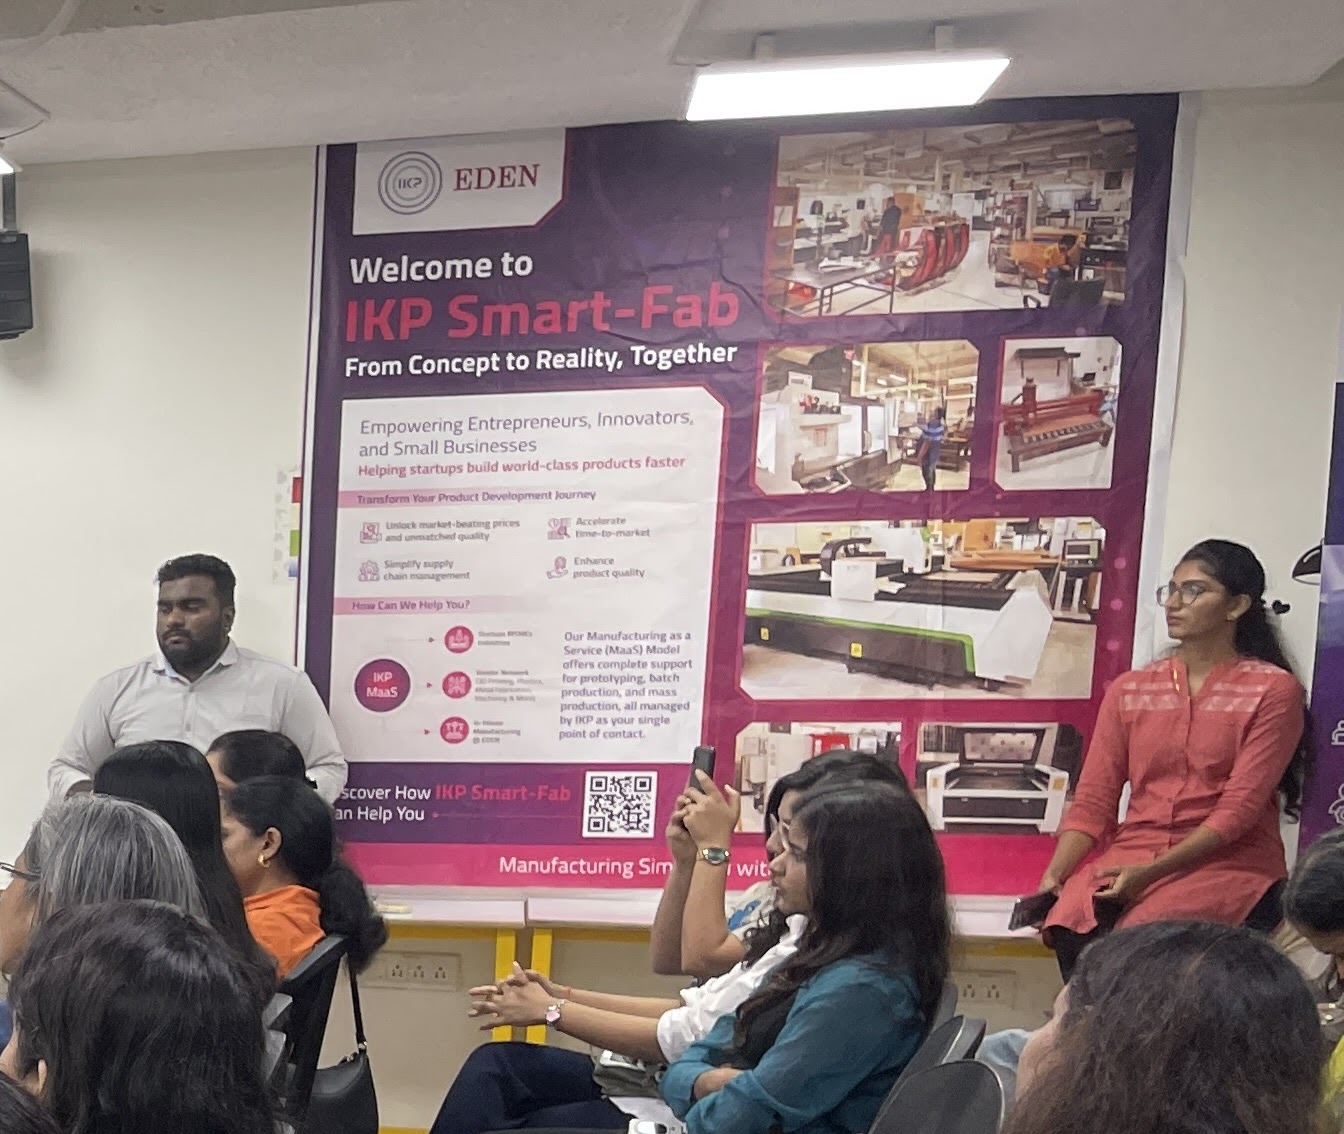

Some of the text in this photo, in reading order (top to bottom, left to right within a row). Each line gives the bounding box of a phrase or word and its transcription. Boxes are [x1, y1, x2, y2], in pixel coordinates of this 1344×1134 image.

[453, 164, 540, 191] EDEN
[350, 252, 533, 284] Welcome to
[346, 281, 740, 342] IKP Smart-Fab
[345, 343, 738, 378] From Concept to Reality, Together
[360, 411, 694, 437] Empowering Entrepreneurs, Innovators,
[359, 439, 537, 457] and Small Businesses
[358, 456, 686, 478] Helping startups build world-class products faster
[357, 490, 596, 505] Transform Your Product Development Journey
[385, 533, 402, 542] and
[458, 532, 490, 542] quality
[423, 560, 454, 570] supply
[573, 568, 646, 579] product quality
[352, 600, 470, 611] How Can We Help You?
[564, 631, 692, 642] Our Manufacturing as a
[564, 645, 602, 655] Service
[646, 644, 680, 654] Model
[562, 660, 692, 671] offers complete support
[373, 672, 392, 682] IKP
[562, 674, 577, 683] for
[650, 674, 680, 682] batch
[366, 686, 398, 698] MaaS
[624, 688, 646, 696] and
[648, 688, 677, 696] mass
[624, 702, 638, 710] all
[640, 702, 690, 713] managed
[560, 716, 670, 726] by IKP as your single
[559, 730, 586, 740] point
[590, 729, 600, 738] of
[341, 784, 572, 801] scover How IKP Smart-Fab
[335, 806, 424, 824] an Help You
[499, 856, 634, 878] Manufacturing
